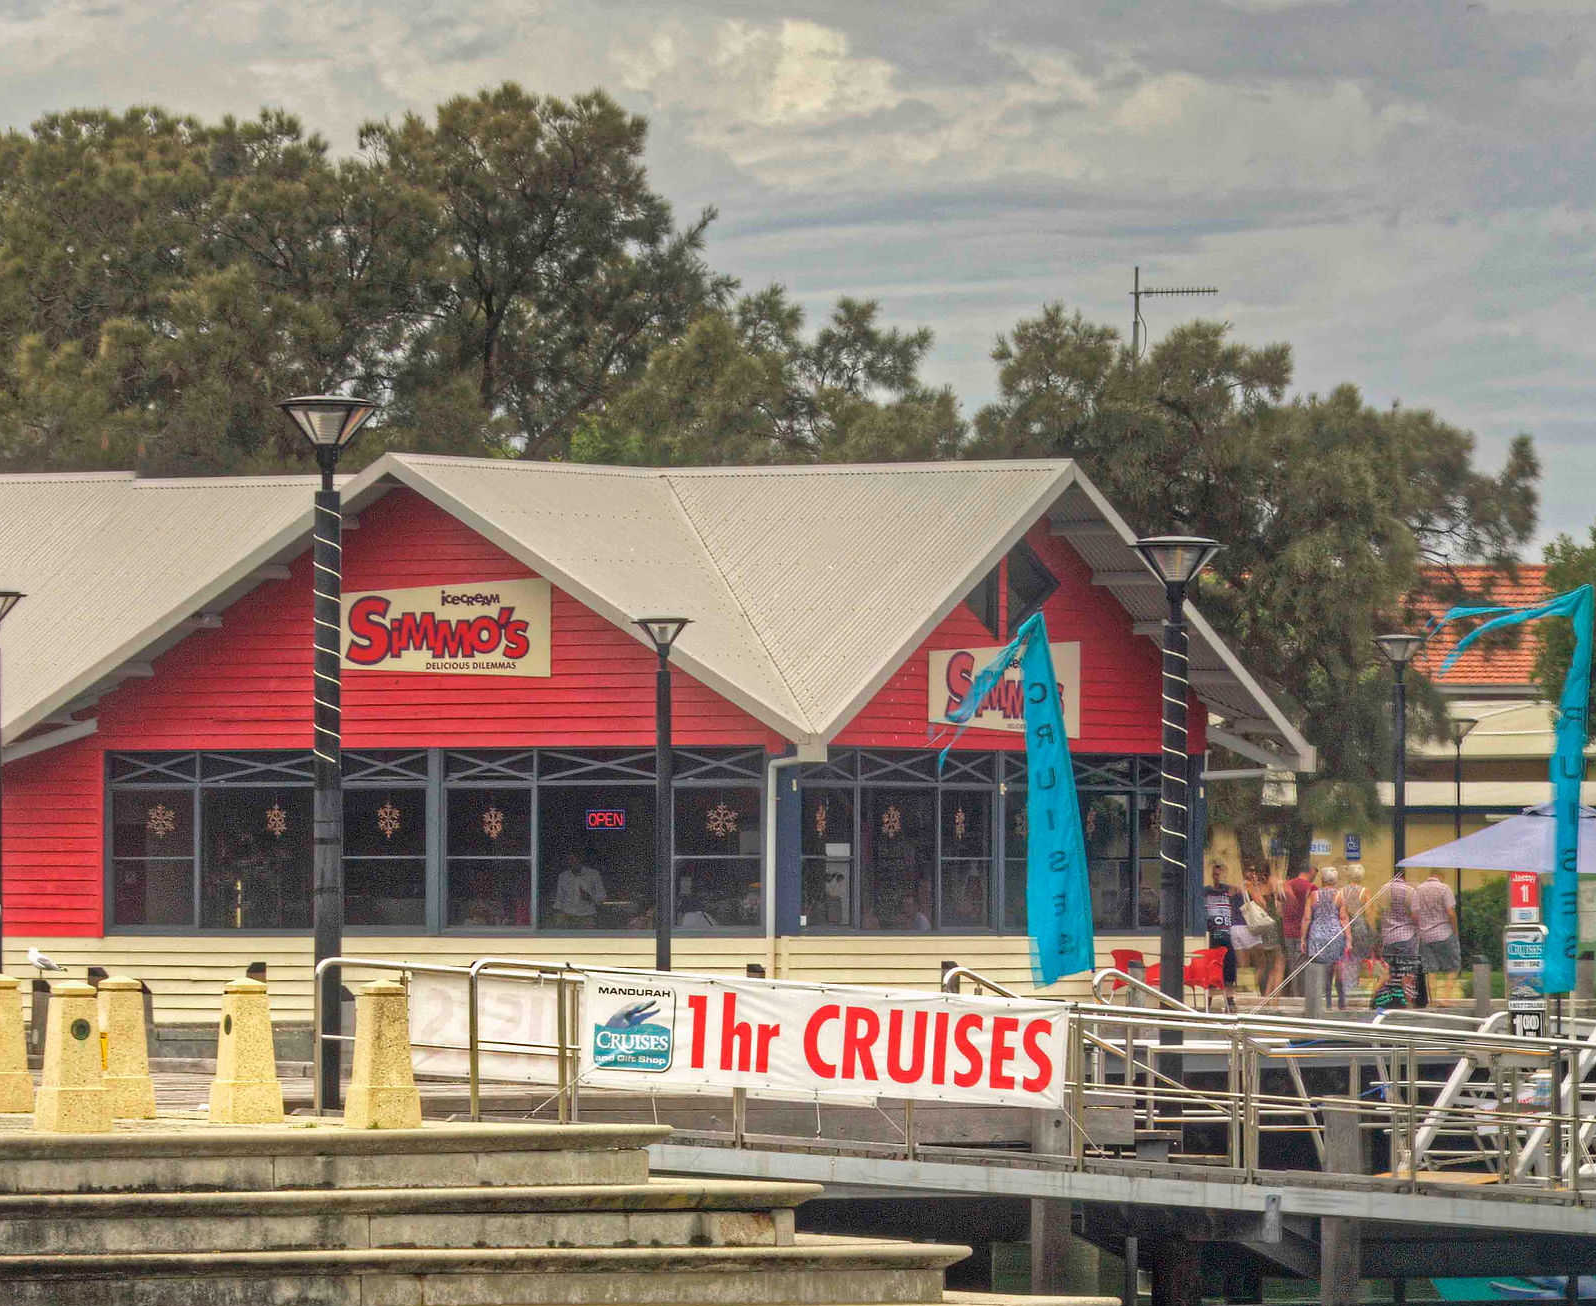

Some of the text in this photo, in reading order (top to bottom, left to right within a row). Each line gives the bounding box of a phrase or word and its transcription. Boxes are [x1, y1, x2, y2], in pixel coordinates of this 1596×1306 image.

[425, 661, 517, 670] DELICIOUS DILEMMAS
[588, 812, 624, 827] OPEN
[598, 986, 671, 998] MANDURAH
[596, 1031, 669, 1053] CRUISES
[804, 1004, 1053, 1093] CRUISES
[595, 1053, 666, 1065] and Gift Shop
